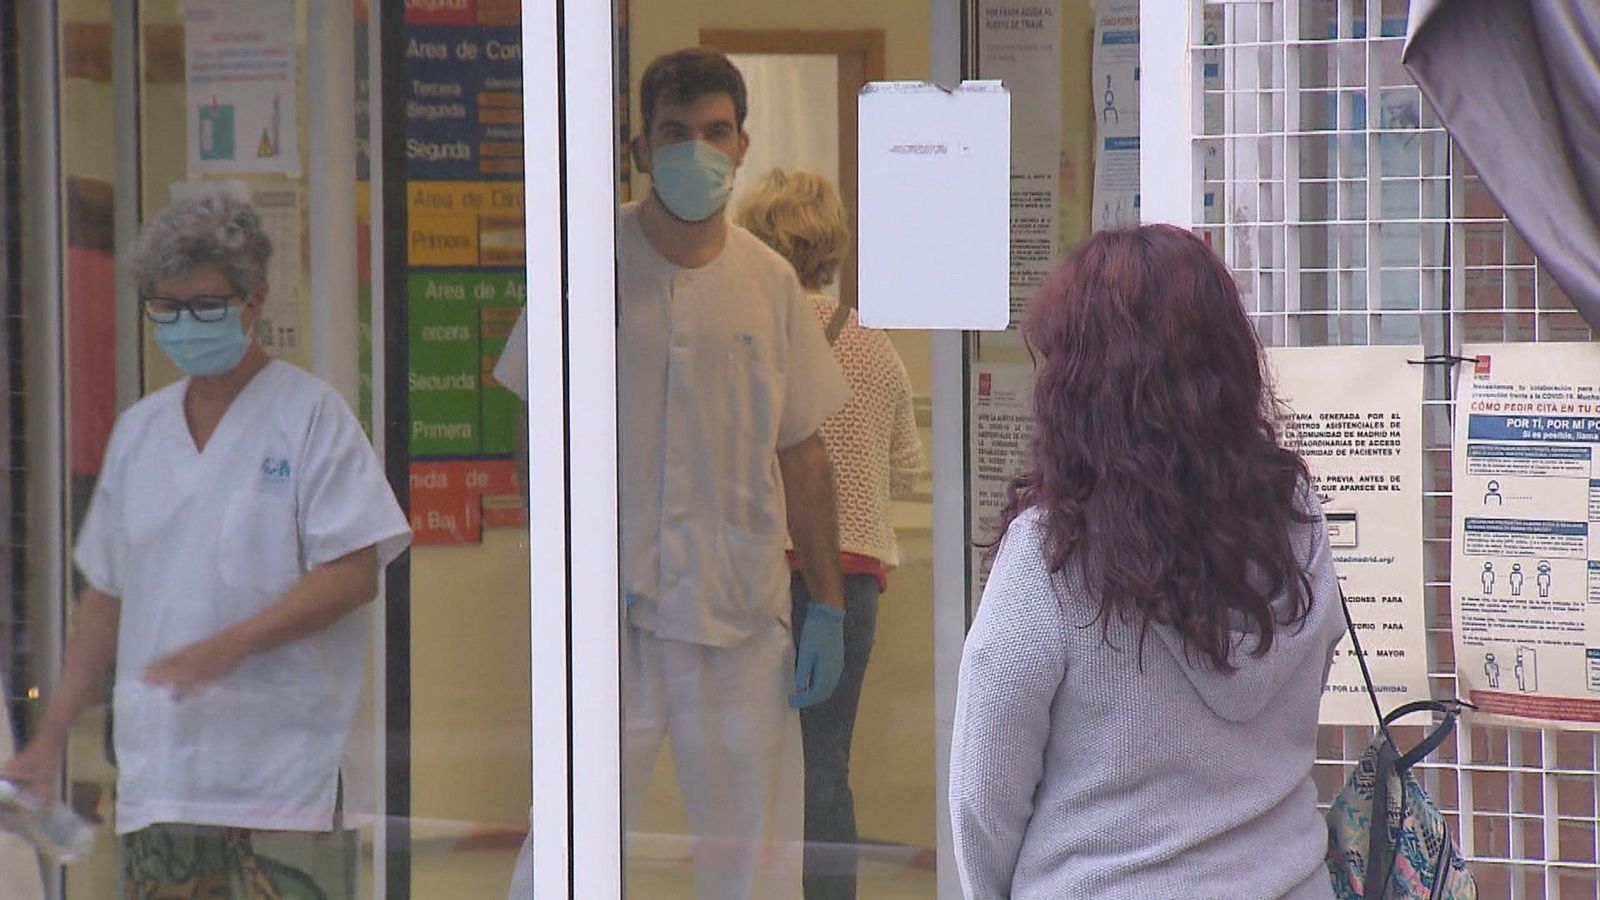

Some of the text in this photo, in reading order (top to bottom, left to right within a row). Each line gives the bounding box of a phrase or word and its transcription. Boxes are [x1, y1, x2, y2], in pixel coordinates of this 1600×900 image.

[406, 39, 447, 59] Area
[456, 40, 478, 60] de
[406, 102, 467, 120] Segunda
[406, 139, 471, 160] Segunda
[462, 190, 483, 208] de
[412, 231, 471, 250] Primera
[424, 281, 465, 300] Area
[474, 281, 495, 300] de
[1471, 401, 1500, 411] CÓMO
[1504, 403, 1533, 412] PEDIR
[1536, 404, 1558, 412] CITA
[1561, 404, 1574, 413] EN
[1578, 405, 1591, 413] TU
[1286, 422, 1320, 430] CENTROS
[1325, 422, 1384, 430] ASISTENCIALES
[1506, 418, 1530, 428] POR
[1547, 419, 1569, 430] POR
[1572, 419, 1585, 430] MÍ
[1284, 439, 1400, 447] EXTRAORDINARIAS DE ACCESO
[1523, 430, 1531, 438] Si
[1543, 431, 1575, 440] posible,
[1577, 431, 1599, 440] llama
[466, 469, 488, 488] de
